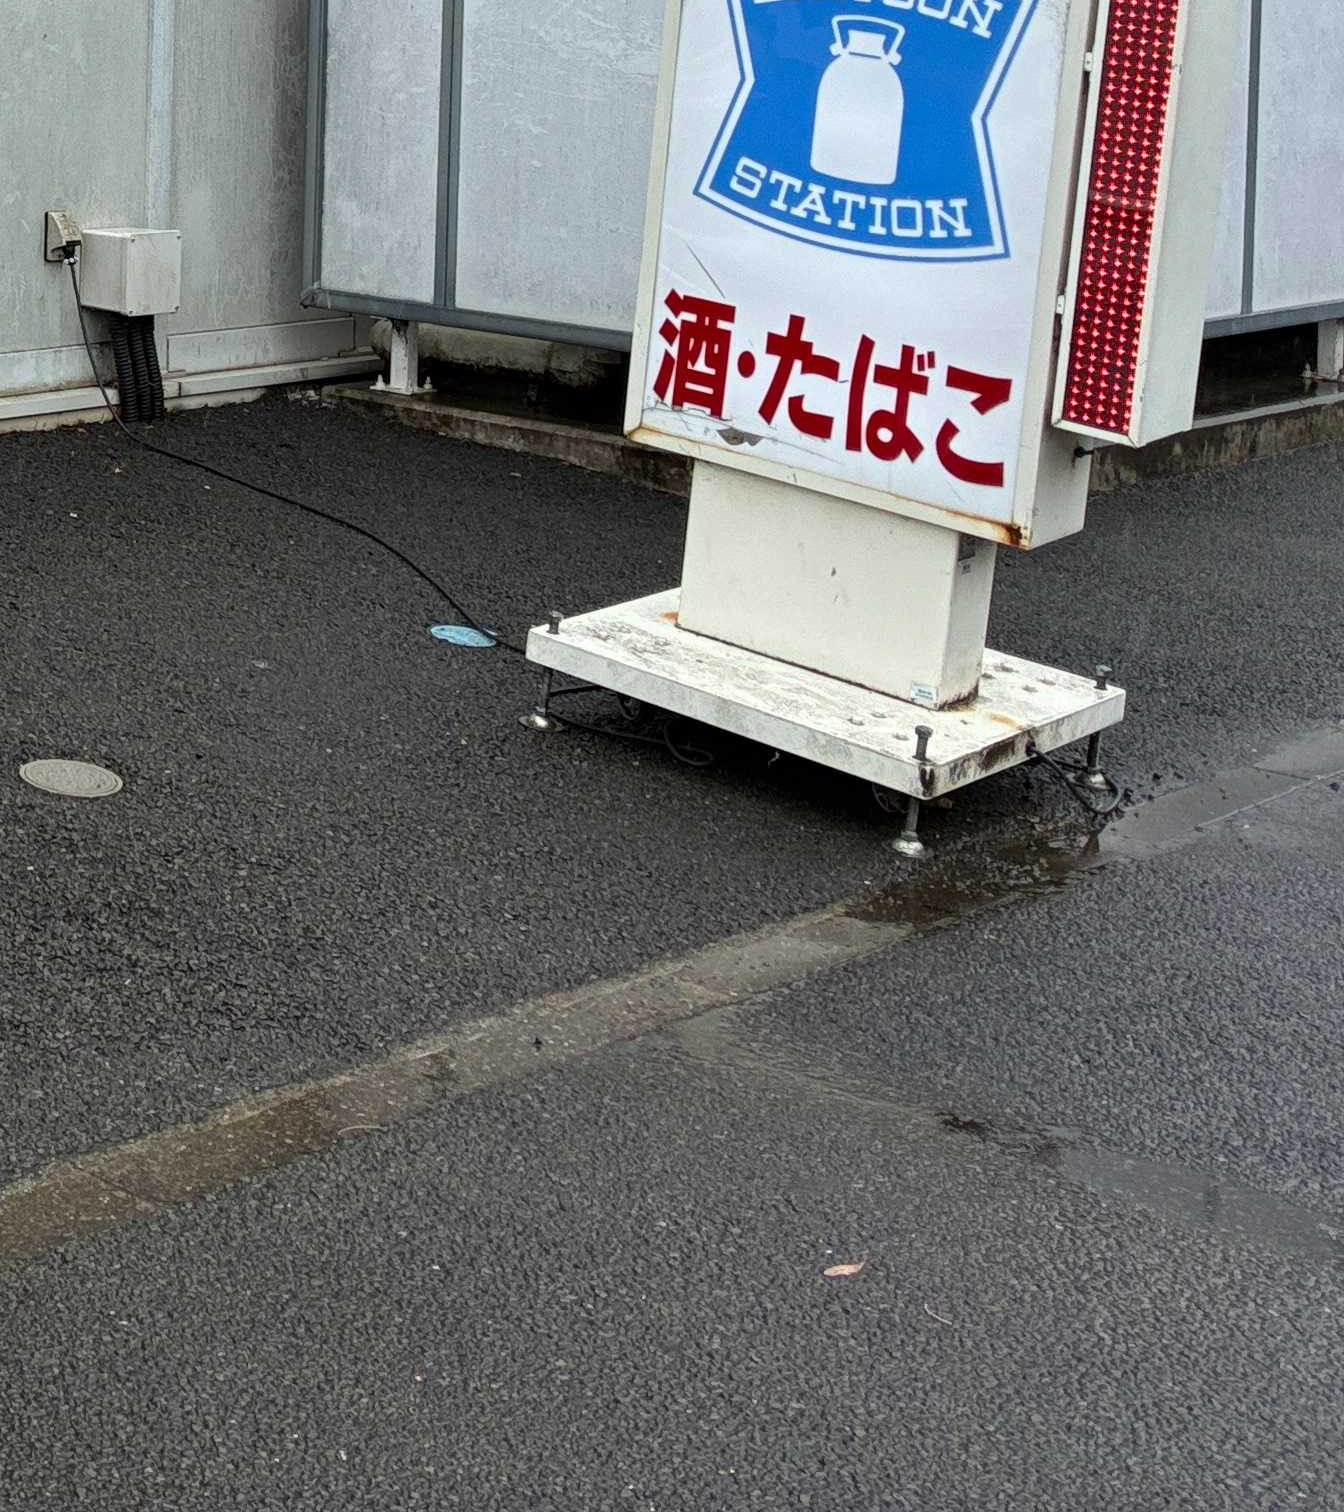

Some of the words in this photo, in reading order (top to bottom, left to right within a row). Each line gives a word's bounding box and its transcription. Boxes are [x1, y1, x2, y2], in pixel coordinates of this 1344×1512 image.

[729, 156, 973, 239] STATION
[653, 288, 1013, 488] 酒・たばこ
